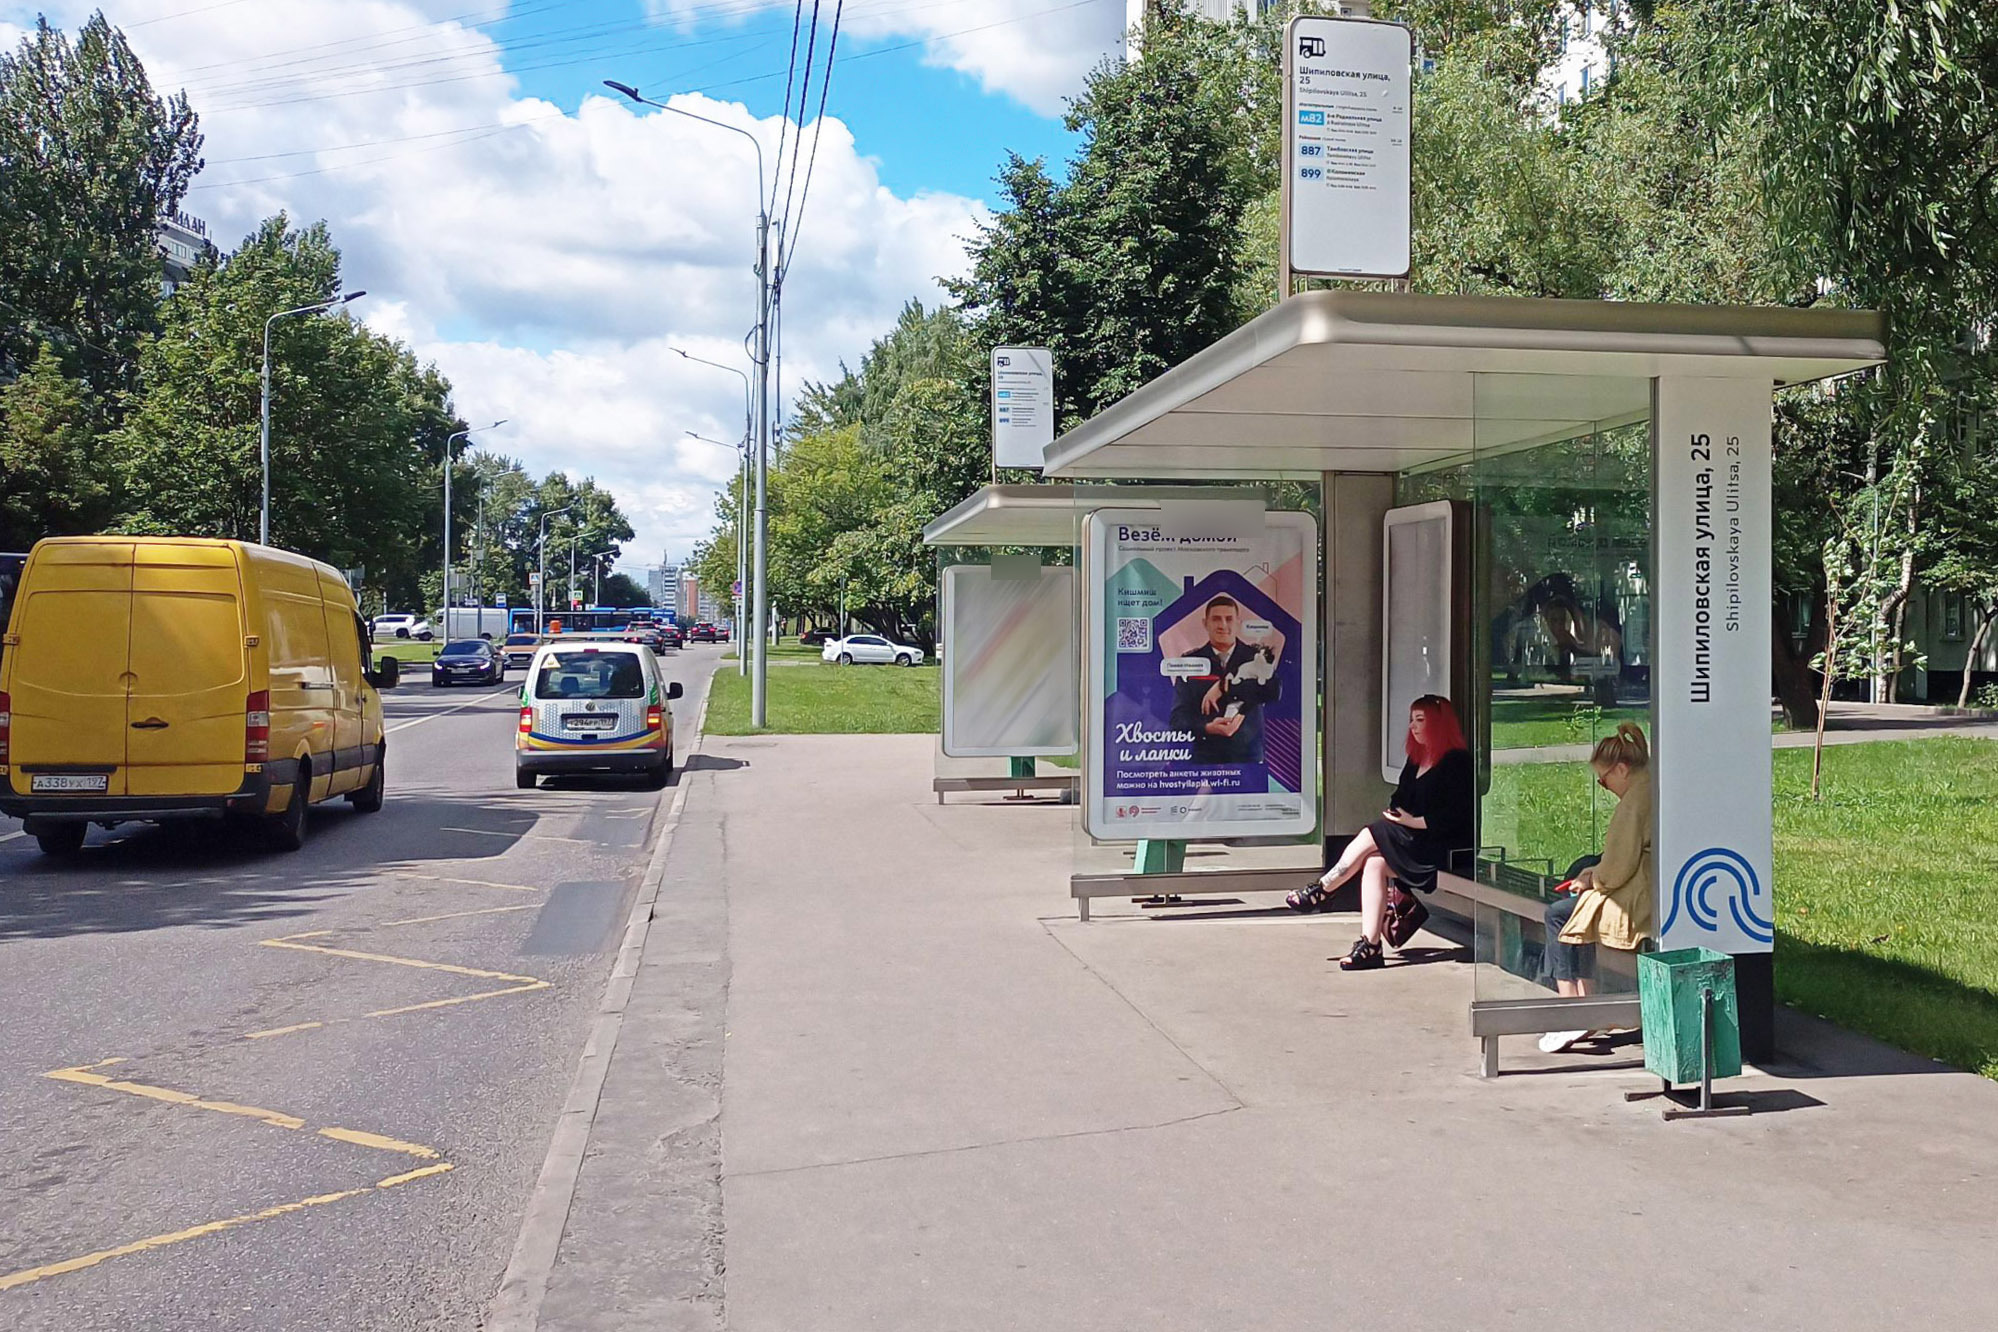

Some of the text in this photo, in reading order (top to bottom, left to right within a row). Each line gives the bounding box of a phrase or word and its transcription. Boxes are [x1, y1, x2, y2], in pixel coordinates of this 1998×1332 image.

[1299, 66, 1390, 81] Шипиловская улица,
[1299, 76, 1311, 84] 25
[1301, 145, 1322, 156] 887
[1301, 168, 1322, 179] 899
[1118, 526, 1175, 542] Везё
[1725, 436, 1742, 632] Shipilovskaya Ulitsa, 25
[1690, 433, 1715, 703] Шипиловская улица, 25
[1117, 587, 1156, 596] Кишмиш
[1117, 598, 1163, 607] ищет дом!
[1115, 721, 1195, 743] Хвосты
[1120, 749, 1192, 761] и лапки
[1116, 769, 1242, 780] Посмотреть анкеты животных
[1116, 782, 1146, 790] можно
[1147, 780, 1158, 789] на
